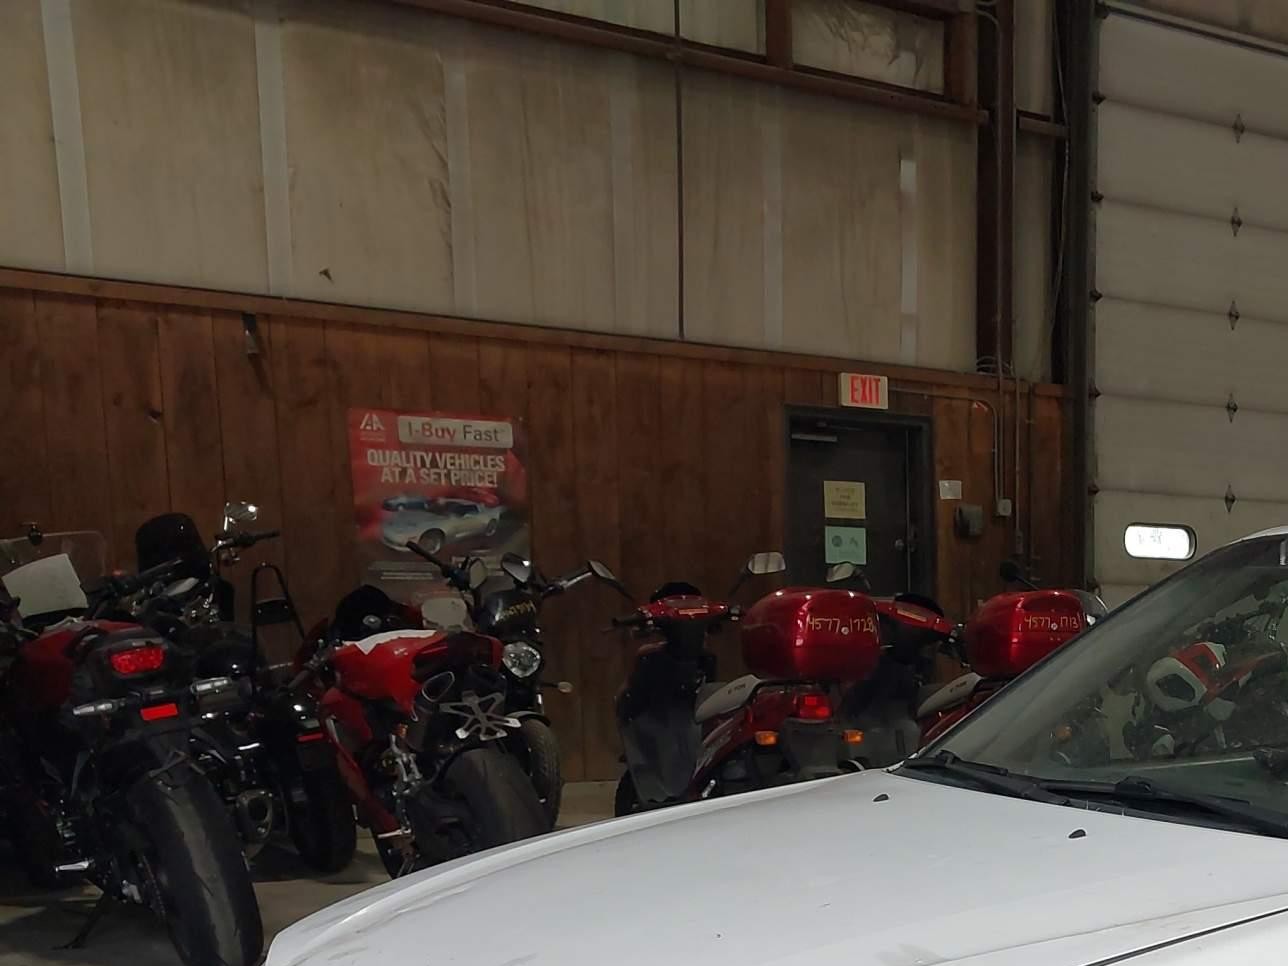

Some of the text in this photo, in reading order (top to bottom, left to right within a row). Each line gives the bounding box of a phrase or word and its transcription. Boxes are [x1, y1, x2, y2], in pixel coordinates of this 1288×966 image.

[850, 373, 881, 405] EXIT
[408, 421, 500, 442] I-Buy Fast
[367, 449, 505, 472] QUALITY VEHICLES
[381, 467, 498, 488] AT A SET PRICE!
